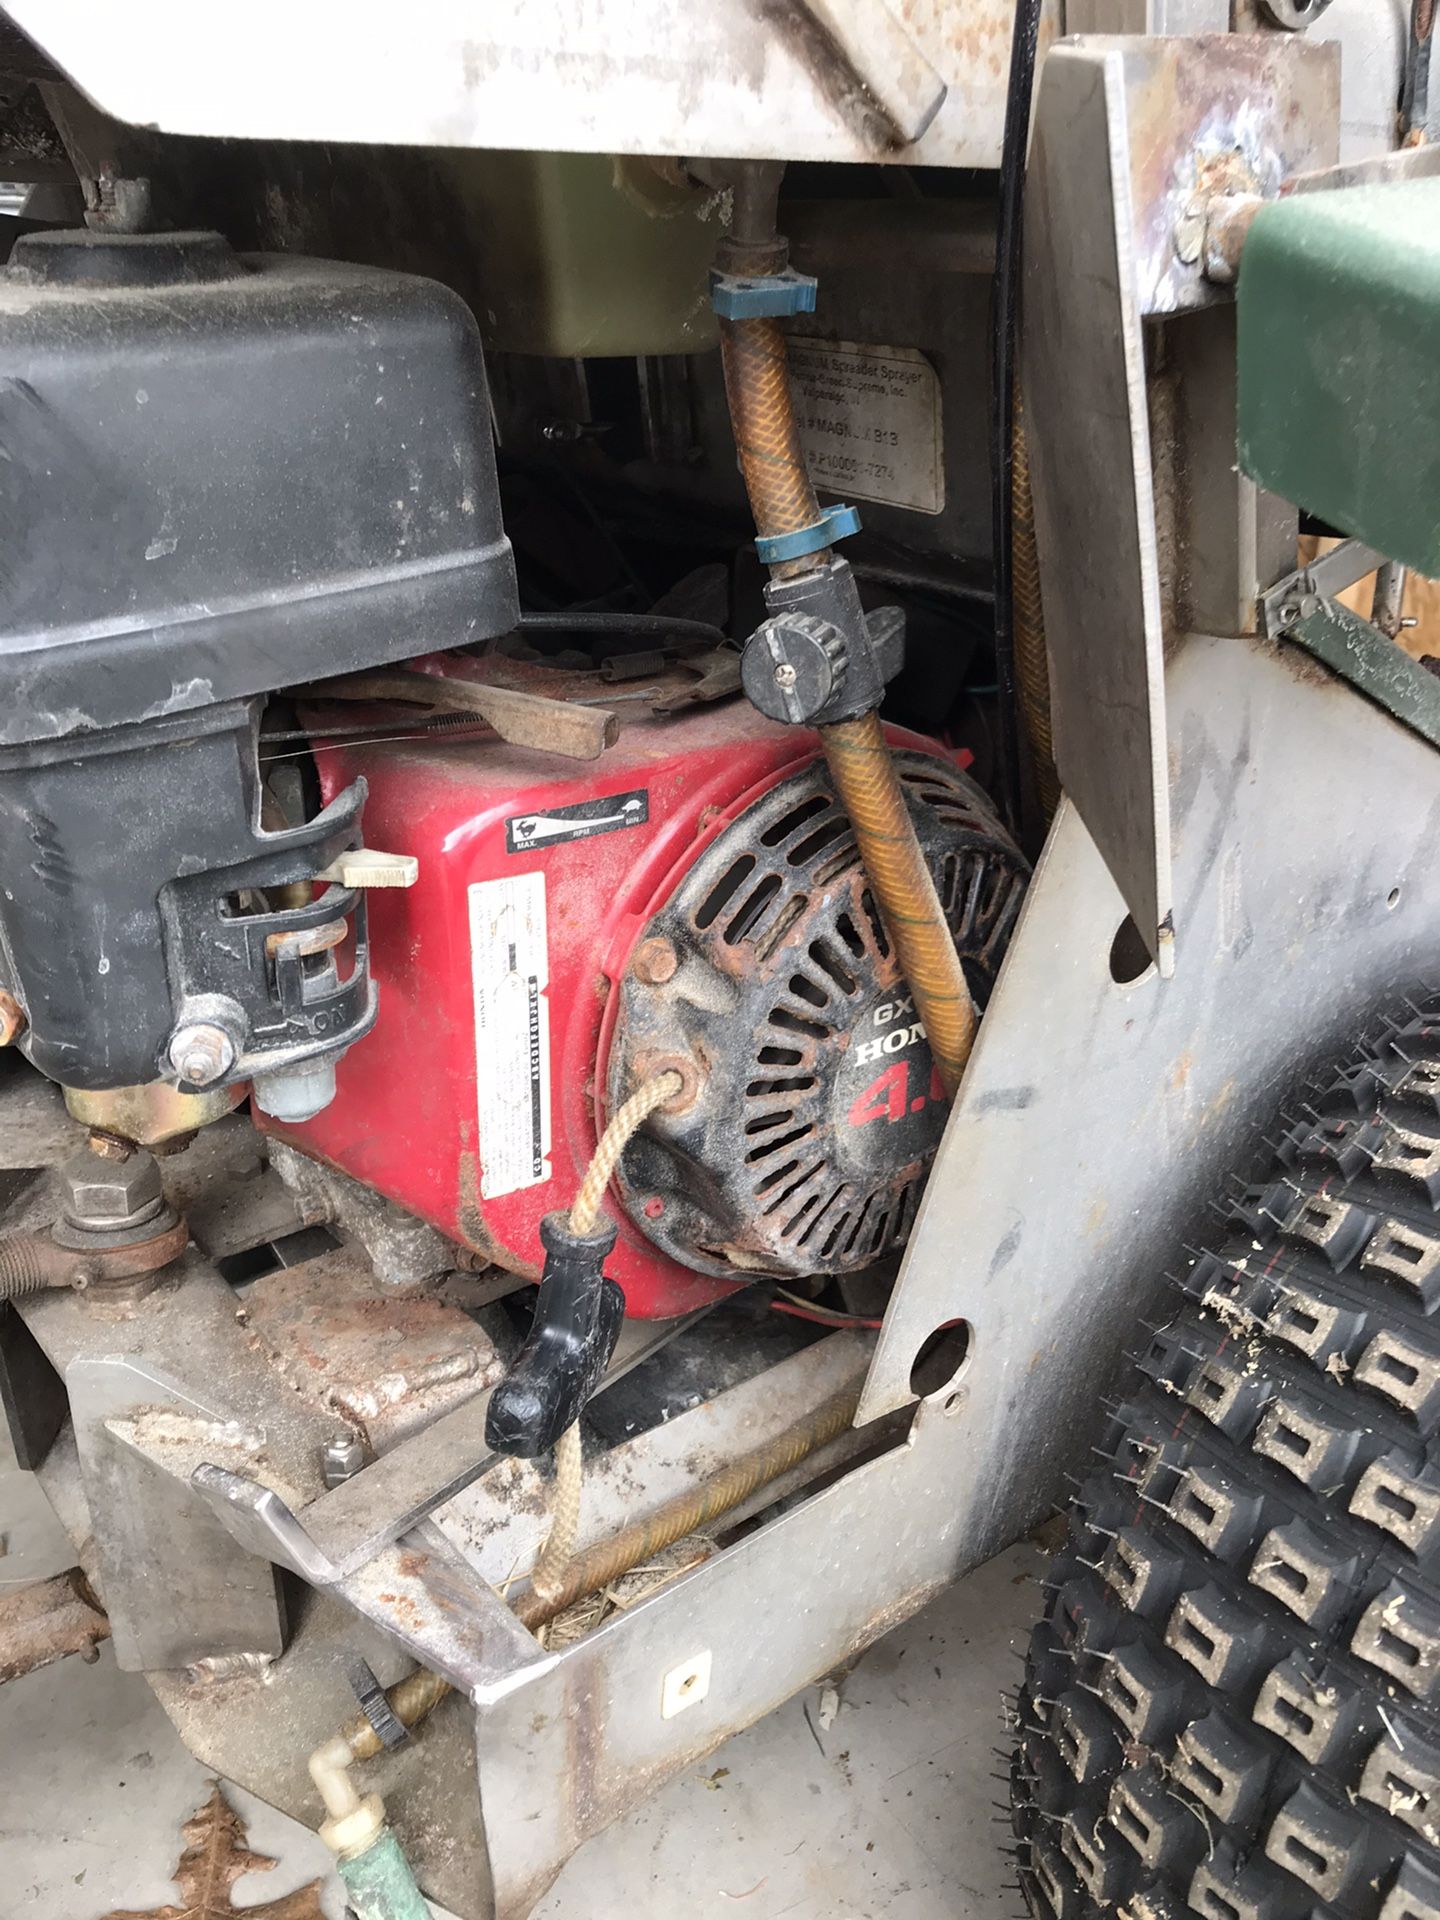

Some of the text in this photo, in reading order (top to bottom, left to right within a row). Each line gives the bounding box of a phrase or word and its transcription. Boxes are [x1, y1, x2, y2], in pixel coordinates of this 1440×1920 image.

[880, 365, 923, 386] Sprayer
[572, 828, 590, 838] RPM
[516, 840, 537, 850] MAX.
[853, 1021, 928, 1068] HON
[847, 1059, 946, 1127] 4.
